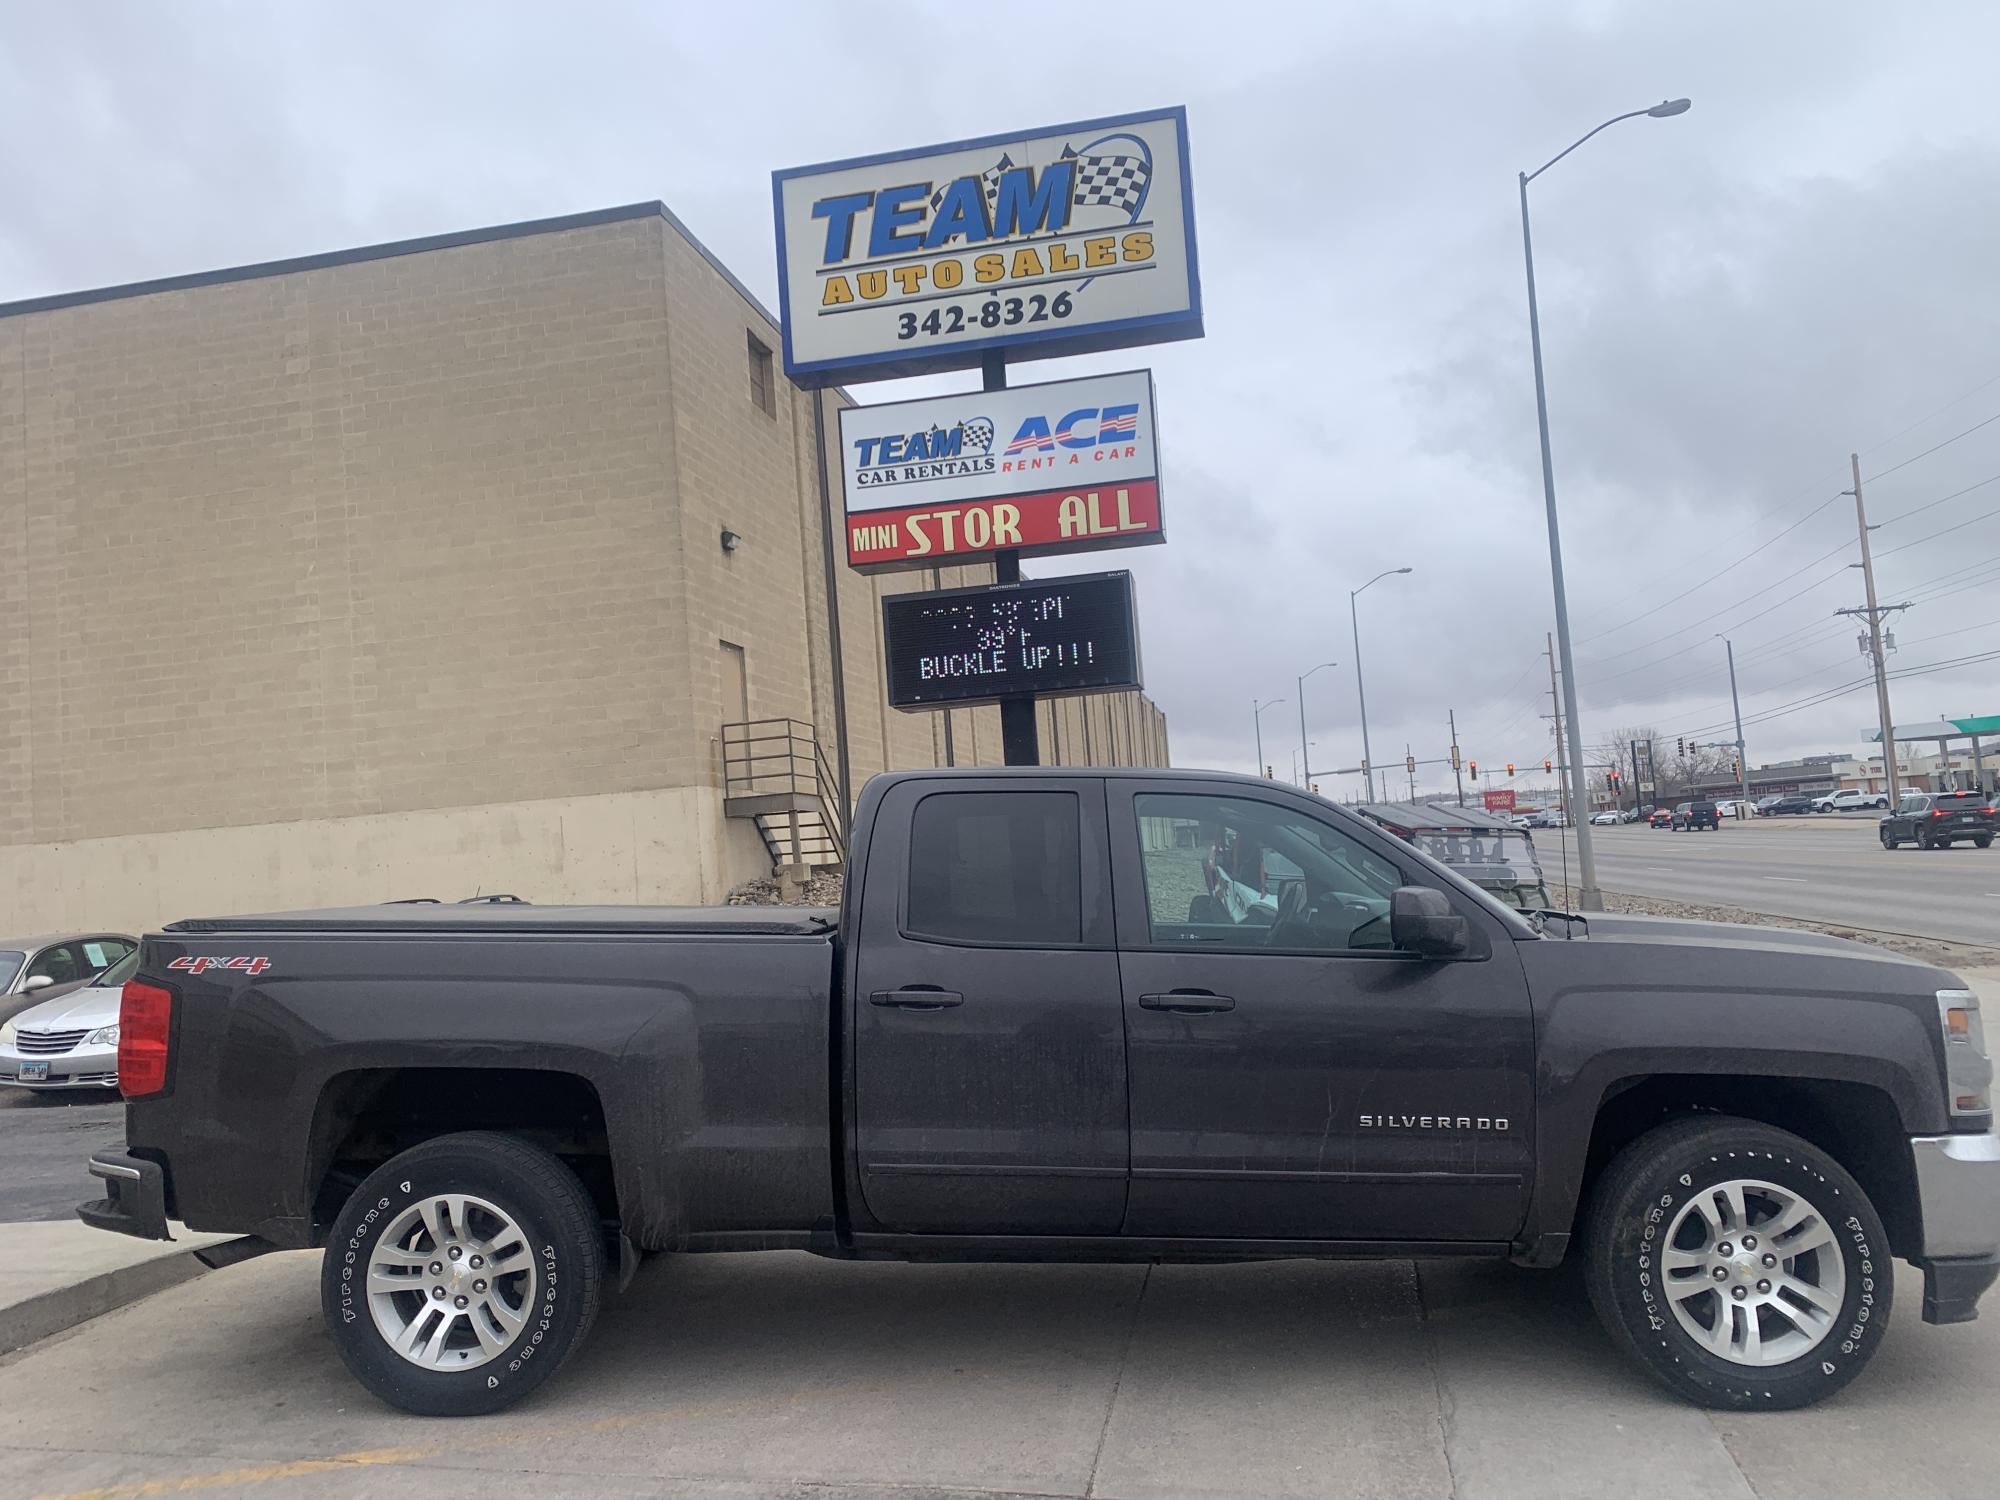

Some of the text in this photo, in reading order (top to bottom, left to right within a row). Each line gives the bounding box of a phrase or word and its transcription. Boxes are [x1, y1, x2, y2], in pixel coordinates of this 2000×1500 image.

[810, 157, 1078, 266] TEAM
[822, 232, 1155, 306] AUTO SALES
[897, 290, 1073, 340] 342-8326
[854, 423, 965, 468] TEAM
[1003, 403, 1140, 456] ACE
[857, 457, 996, 485] CAR RENTALS
[1002, 446, 1136, 473] RENT A CAR
[852, 489, 1148, 556] MINI STOR ALL
[919, 641, 1094, 680] BUCKLE UP!!!
[1359, 1115, 1509, 1131] SILVERADO
[341, 1197, 390, 1324] Firestone
[1639, 1193, 1673, 1331] Firestone
[509, 1245, 557, 1372] Firestone
